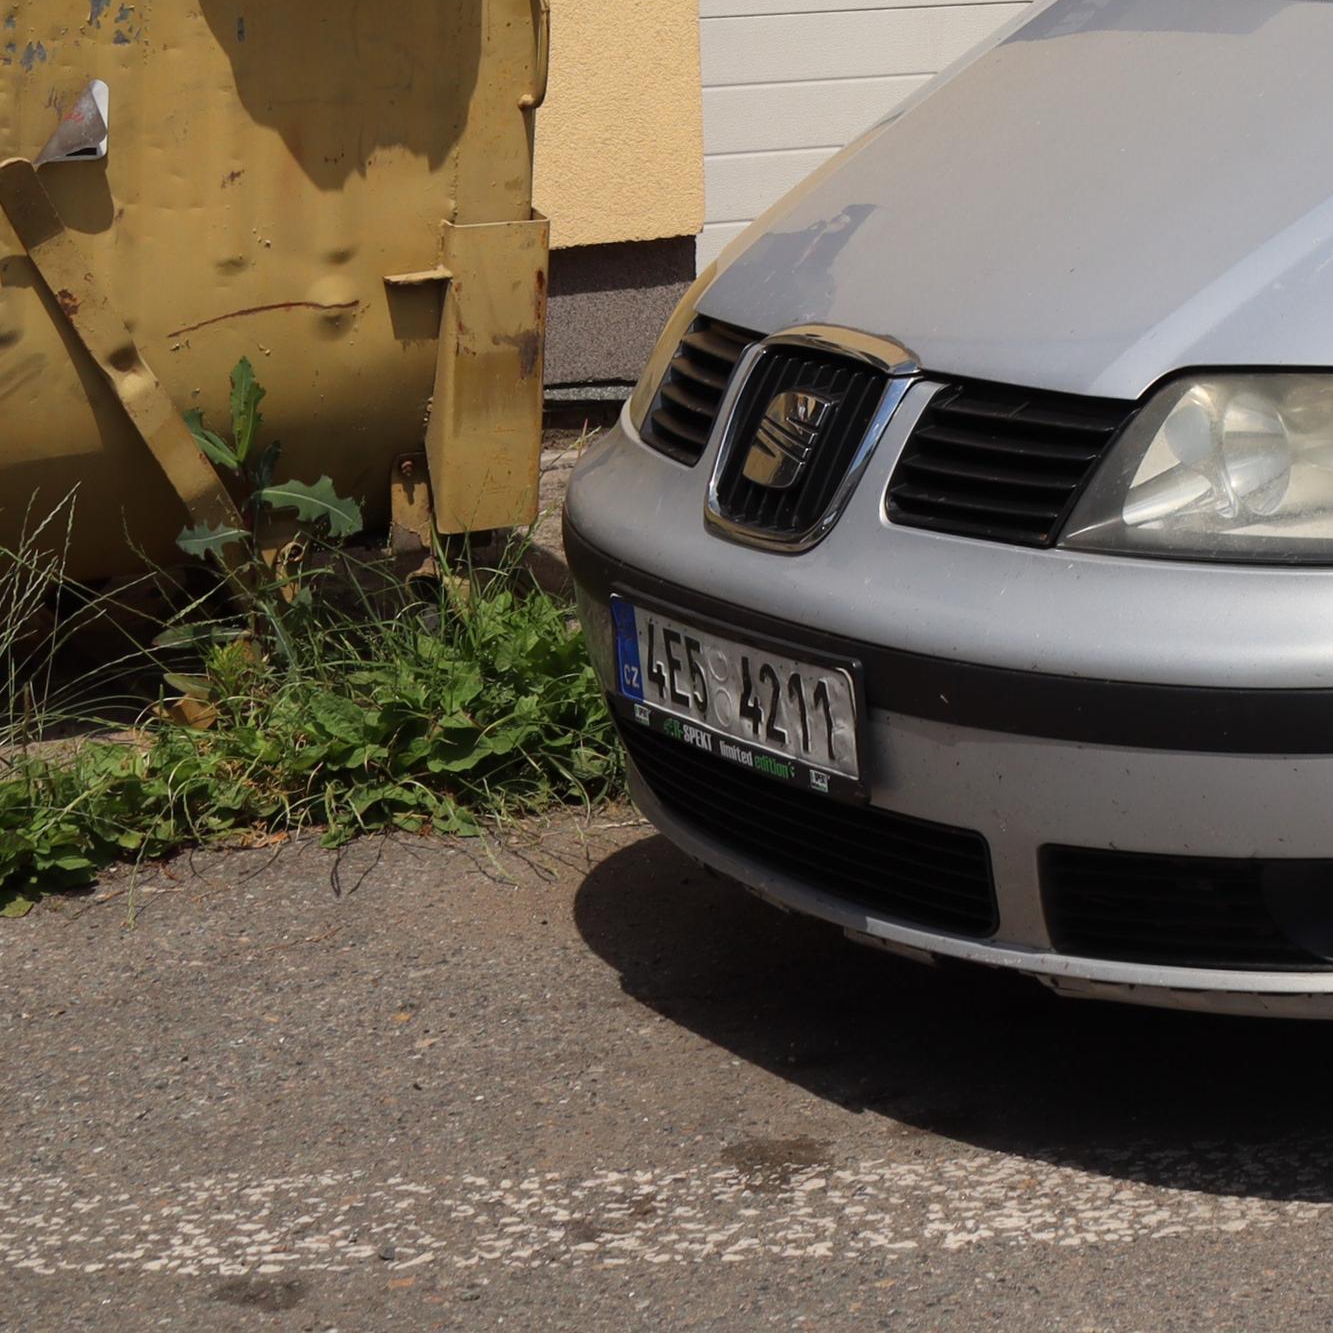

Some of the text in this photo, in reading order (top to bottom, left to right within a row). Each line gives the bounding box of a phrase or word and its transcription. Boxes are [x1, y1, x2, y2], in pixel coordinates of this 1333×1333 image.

[624, 663, 640, 689] CZ
[739, 655, 837, 761] 4211
[720, 740, 753, 766] limited
